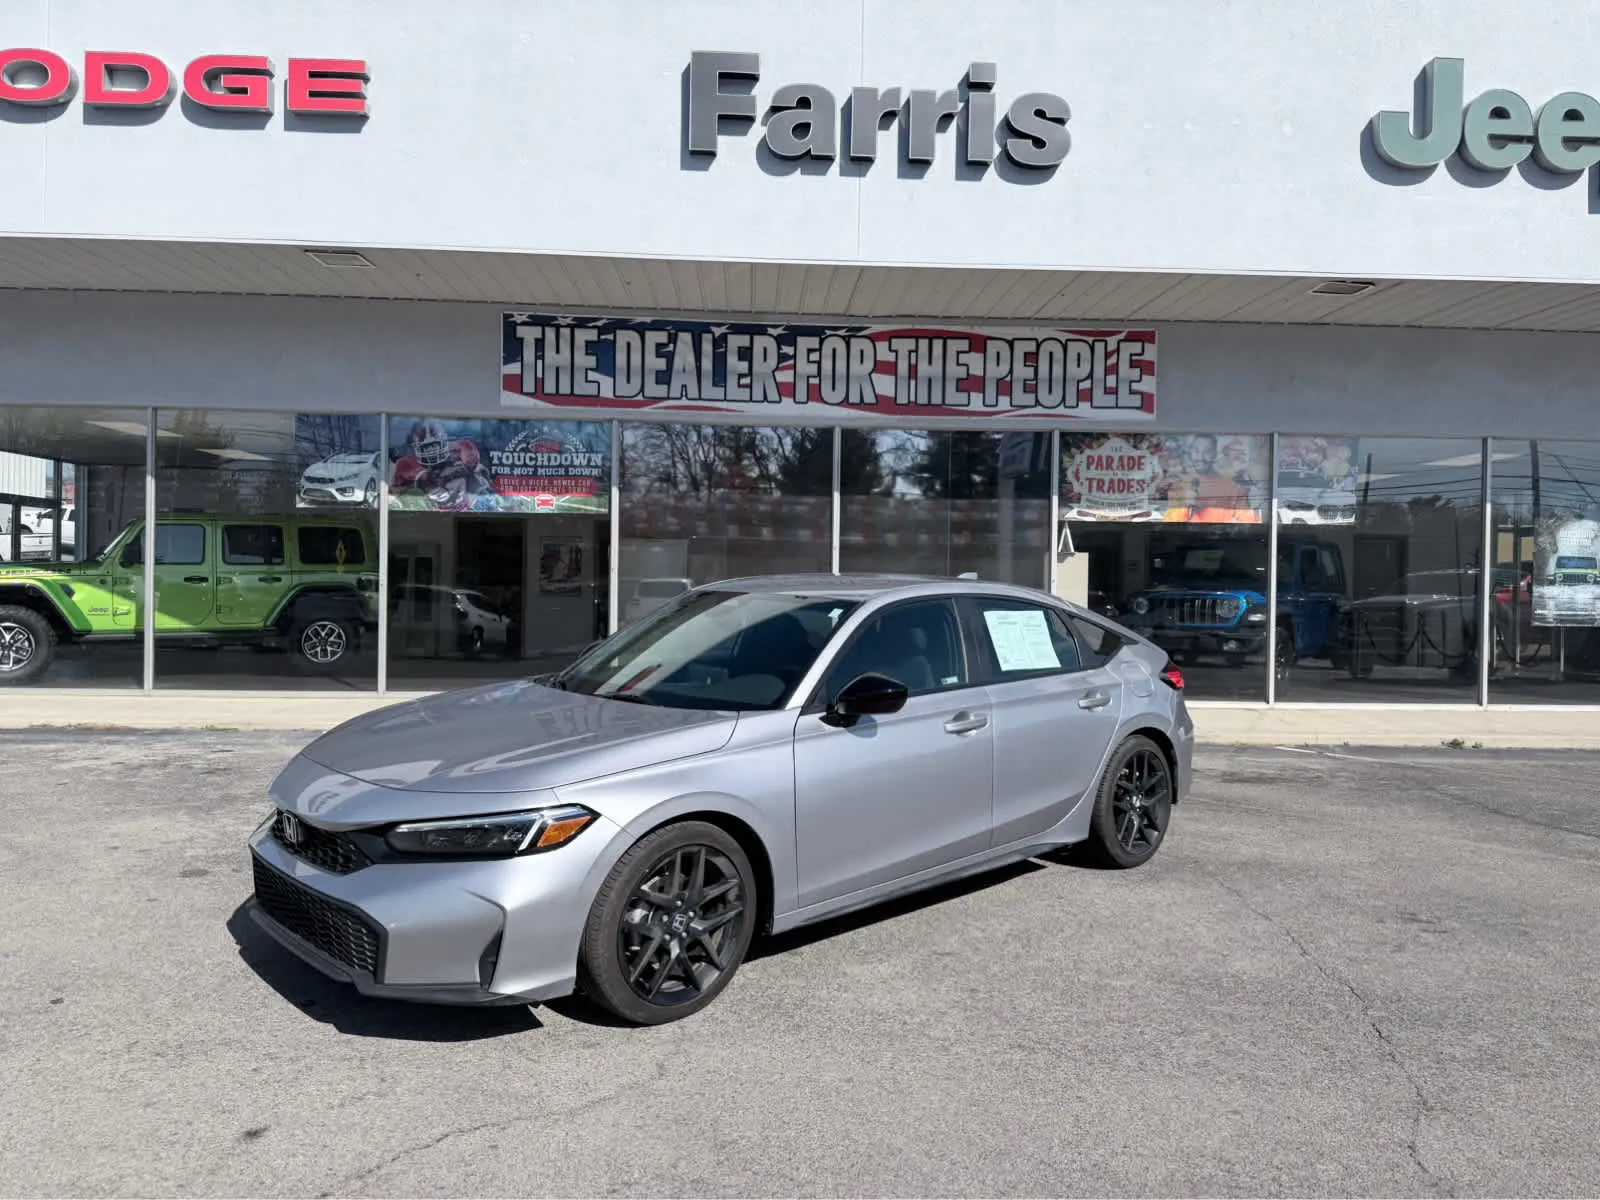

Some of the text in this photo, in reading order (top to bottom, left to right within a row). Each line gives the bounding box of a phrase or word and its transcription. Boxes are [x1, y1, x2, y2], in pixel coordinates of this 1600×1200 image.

[689, 50, 1072, 169] Farris
[516, 325, 1145, 408] THE DEALER FOR THE PEOPLE
[489, 451, 604, 466] TOUCHDOWN
[1086, 455, 1146, 472] PARADE
[491, 466, 511, 475] FOR
[513, 467, 534, 475] NOT
[537, 467, 565, 476] MUCH
[1086, 477, 1146, 495] TRADES
